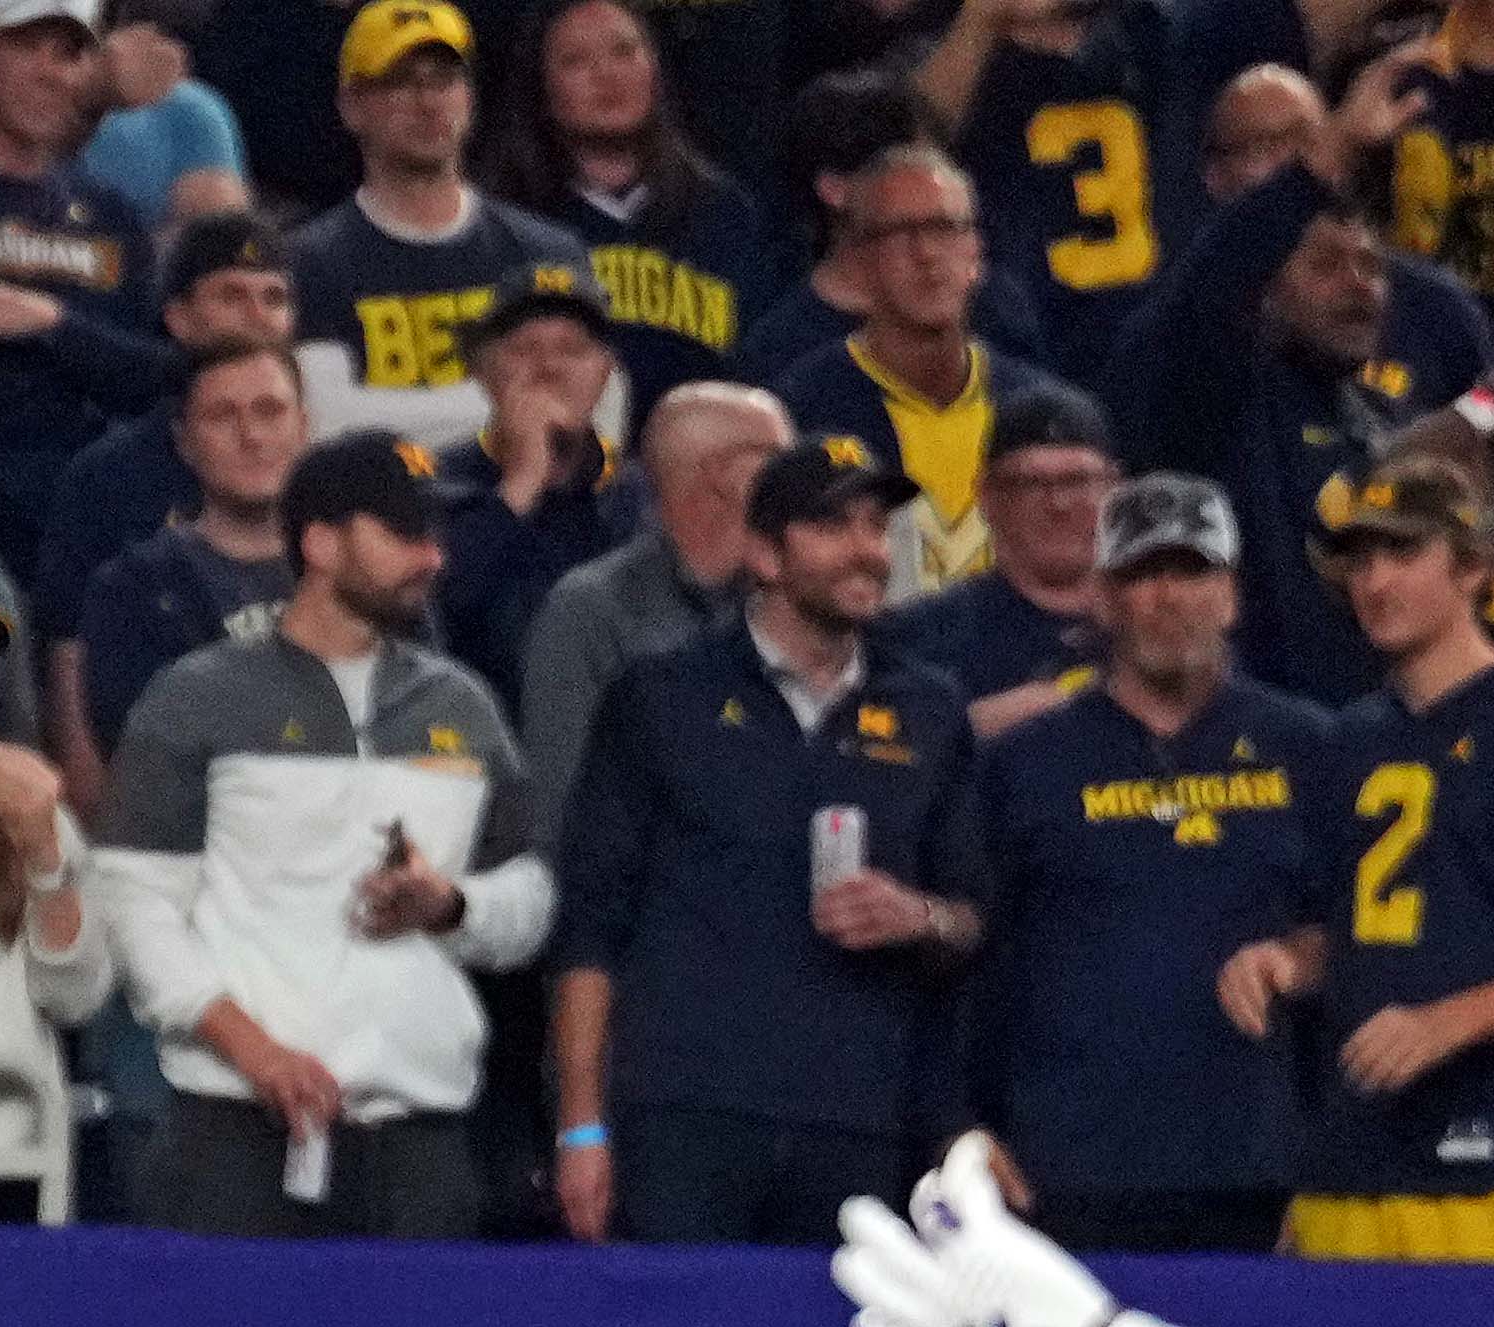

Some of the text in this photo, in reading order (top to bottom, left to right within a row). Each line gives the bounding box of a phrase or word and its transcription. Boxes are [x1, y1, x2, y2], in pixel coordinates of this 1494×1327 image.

[1027, 101, 1157, 289] 3
[591, 244, 738, 351] HIGAN
[1356, 761, 1436, 946] 2
